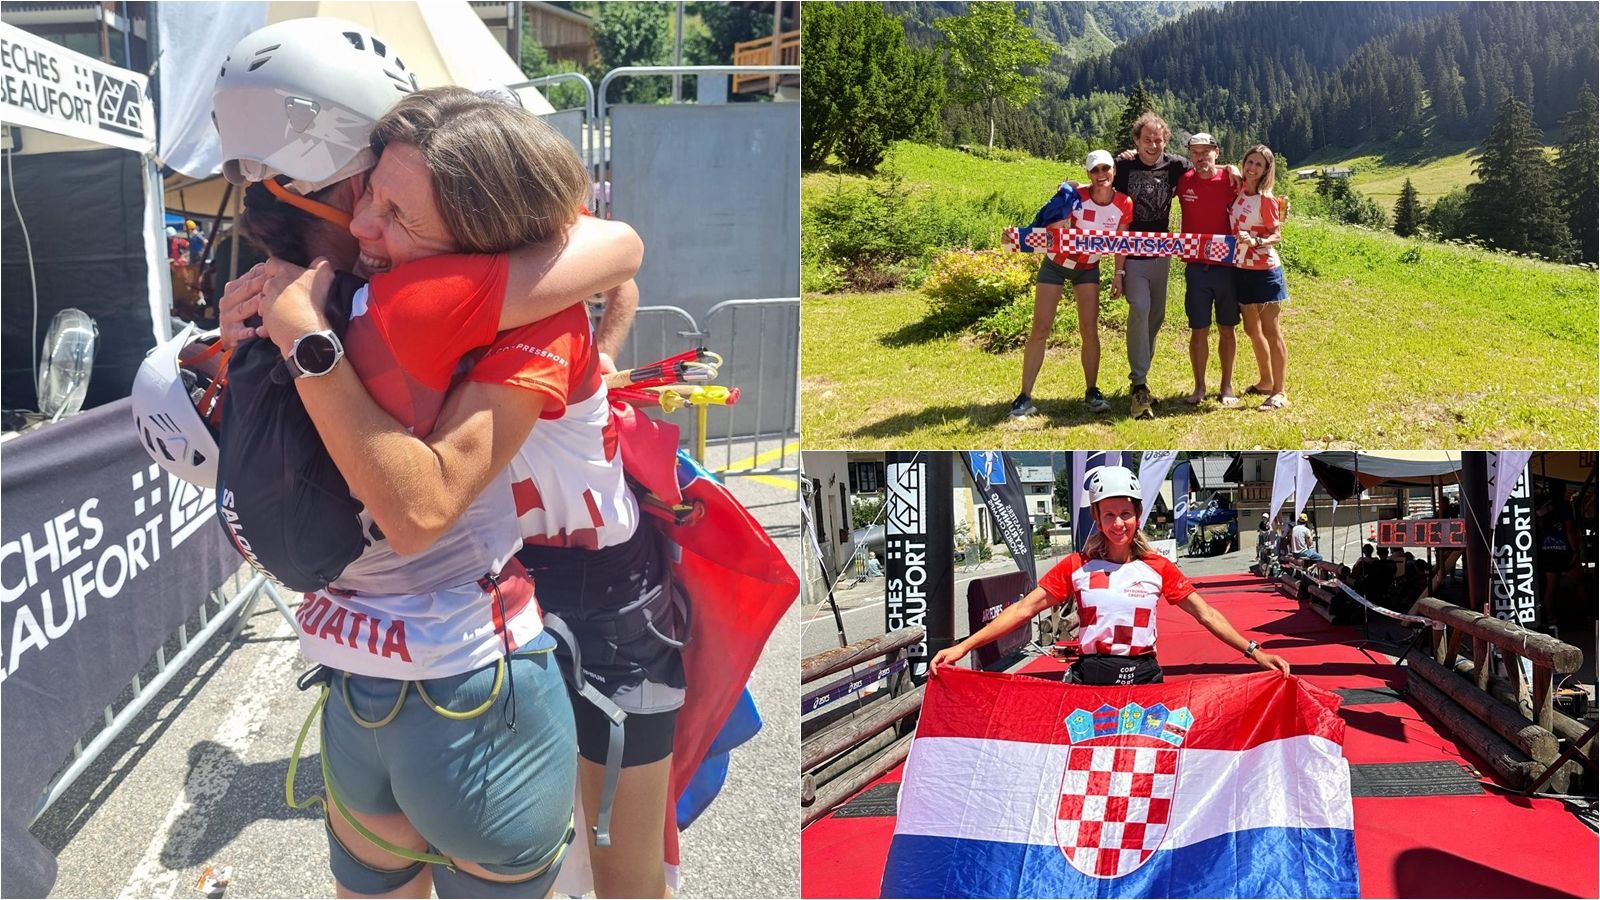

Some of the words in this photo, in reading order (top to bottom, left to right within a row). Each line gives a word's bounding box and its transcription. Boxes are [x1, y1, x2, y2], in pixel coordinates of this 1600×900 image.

[1075, 236, 1185, 253] HRVATSKA
[0, 497, 104, 603] CHES
[1514, 504, 1535, 623] BEAUFORT
